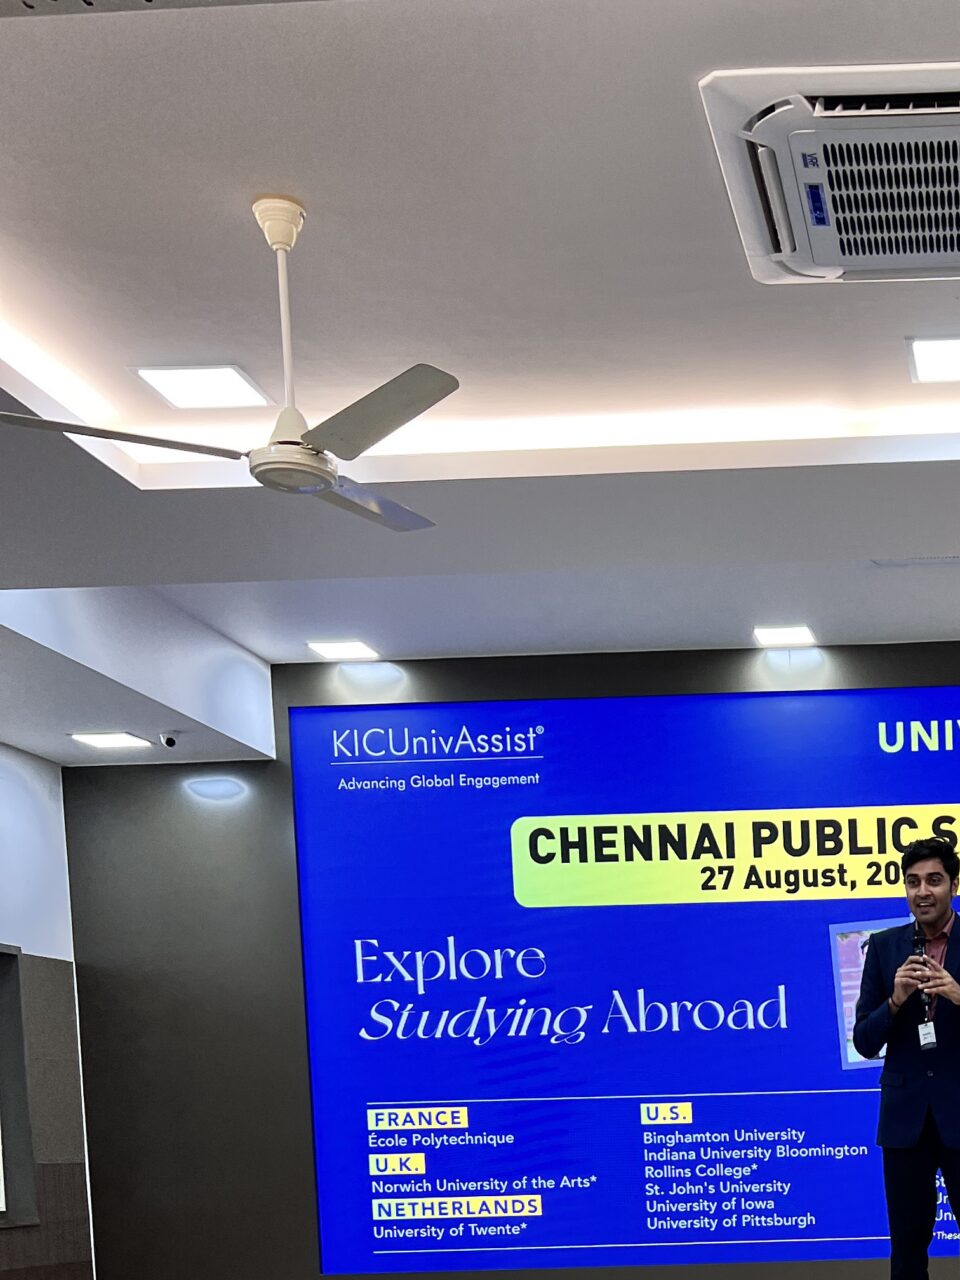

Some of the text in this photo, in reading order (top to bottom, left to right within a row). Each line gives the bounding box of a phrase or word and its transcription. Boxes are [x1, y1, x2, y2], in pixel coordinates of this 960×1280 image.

[337, 772, 540, 792] Advancing Global Engagement
[528, 822, 736, 865] CHENNAI
[752, 817, 919, 858] PUBLIC
[700, 865, 735, 891] 27
[743, 863, 857, 894] August,
[353, 935, 547, 995] Explore
[358, 984, 788, 1046] Studying Abroad
[374, 1110, 462, 1127] FRANCE
[646, 1105, 687, 1121] U.S.
[368, 1131, 515, 1149] École Polytechnique
[643, 1127, 806, 1147] Binghamton University
[644, 1143, 868, 1162] Indiana University Bloomington
[375, 1157, 419, 1173] U.K.
[644, 1164, 692, 1179] Rollins
[371, 1178, 432, 1193] Norwich
[436, 1177, 508, 1193] University
[512, 1175, 528, 1190] of
[530, 1175, 556, 1189] the
[645, 1179, 791, 1196] St. John's University
[377, 1198, 538, 1217] NETHERLANDS
[646, 1196, 775, 1215] University of Iowa
[647, 1212, 816, 1232] University of Pittsburgh
[373, 1224, 445, 1241] University
[449, 1223, 465, 1237] of
